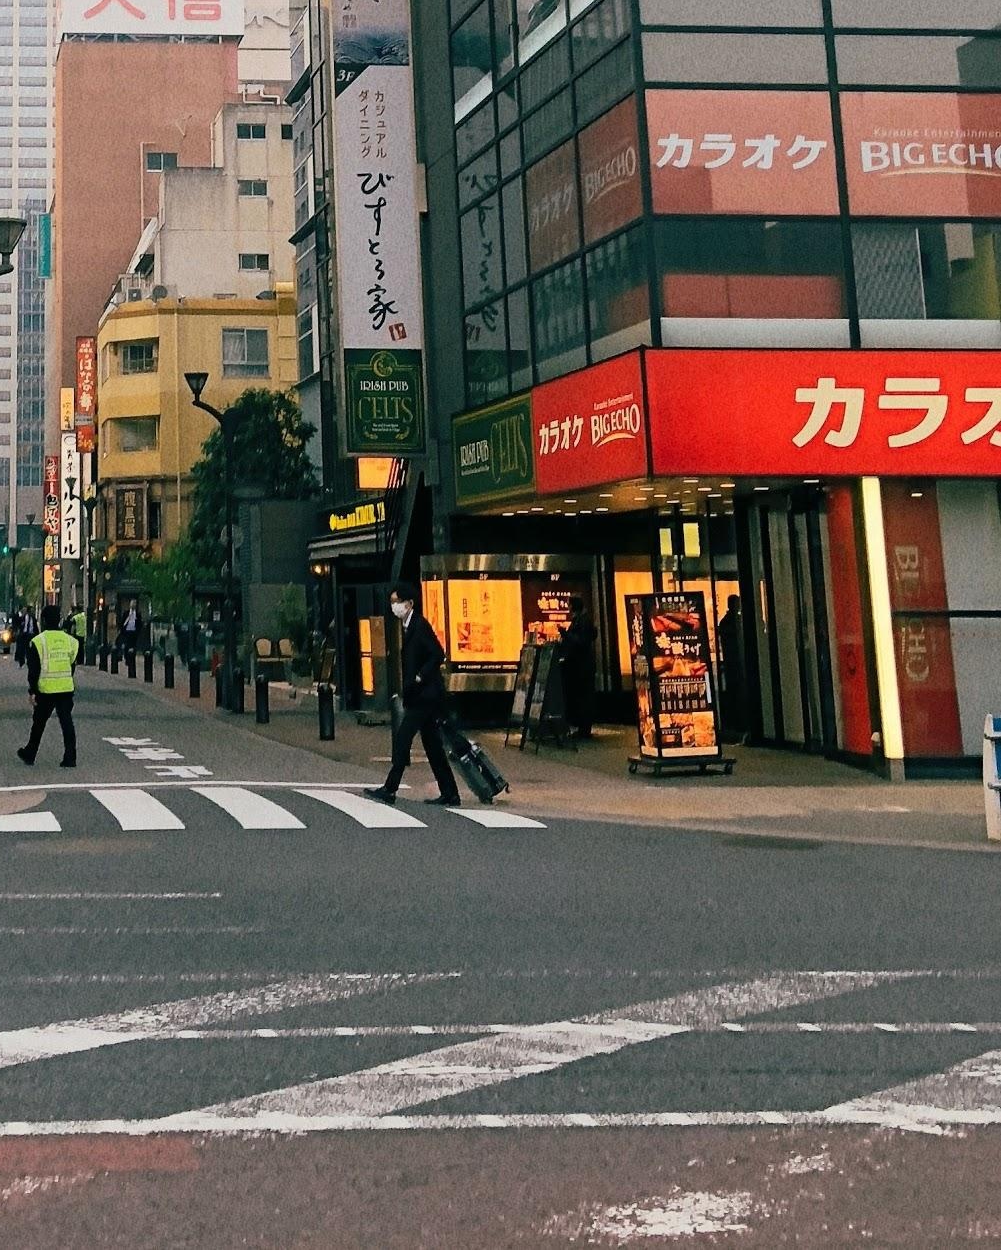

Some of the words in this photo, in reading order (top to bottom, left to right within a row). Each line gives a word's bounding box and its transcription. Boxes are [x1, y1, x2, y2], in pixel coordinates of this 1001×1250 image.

[357, 90, 375, 160] ダイニング
[374, 90, 388, 160] カジュアル
[604, 146, 637, 184] ECHO
[656, 132, 828, 171] カラオケ
[860, 140, 926, 174] BIG
[356, 172, 400, 331] びすとろ家
[360, 380, 387, 392] IRISH
[388, 380, 410, 392] PUB
[358, 396, 414, 424] CELTS
[590, 413, 611, 446] BIG
[610, 403, 641, 434] ECHO
[476, 439, 490, 463] PUB
[539, 414, 584, 456] カラオケ
